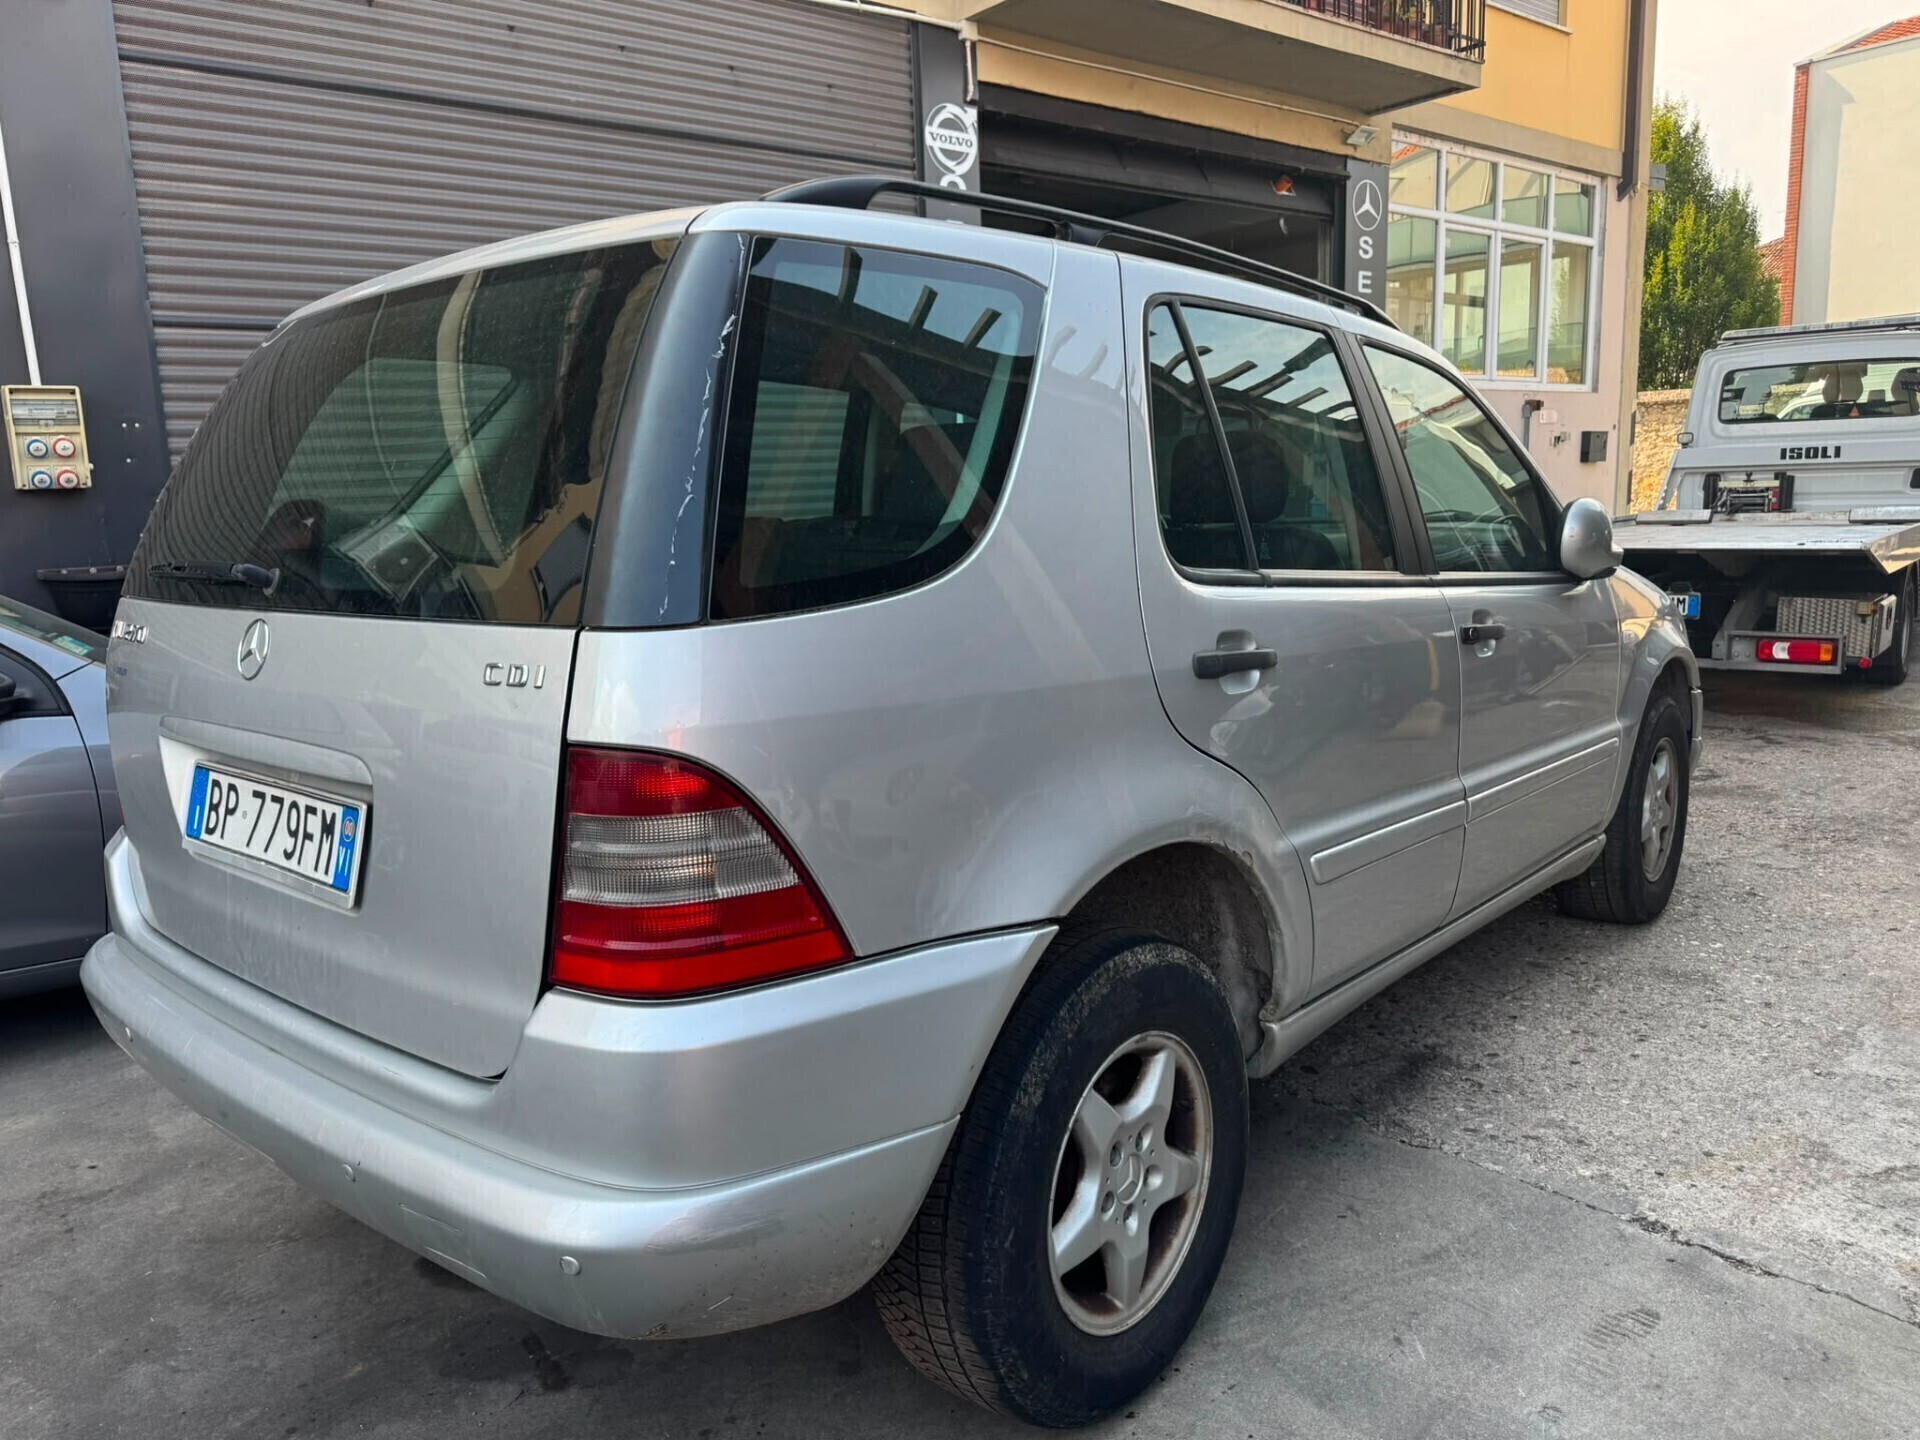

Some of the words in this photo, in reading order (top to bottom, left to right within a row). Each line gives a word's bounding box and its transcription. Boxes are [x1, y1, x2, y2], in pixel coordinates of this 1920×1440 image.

[928, 131, 973, 148] VOLVO
[1780, 446, 1841, 460] ISOLI
[483, 663, 546, 689] CDI
[204, 778, 240, 840] BP
[246, 789, 337, 877] 779FM
[338, 845, 351, 877] VI
